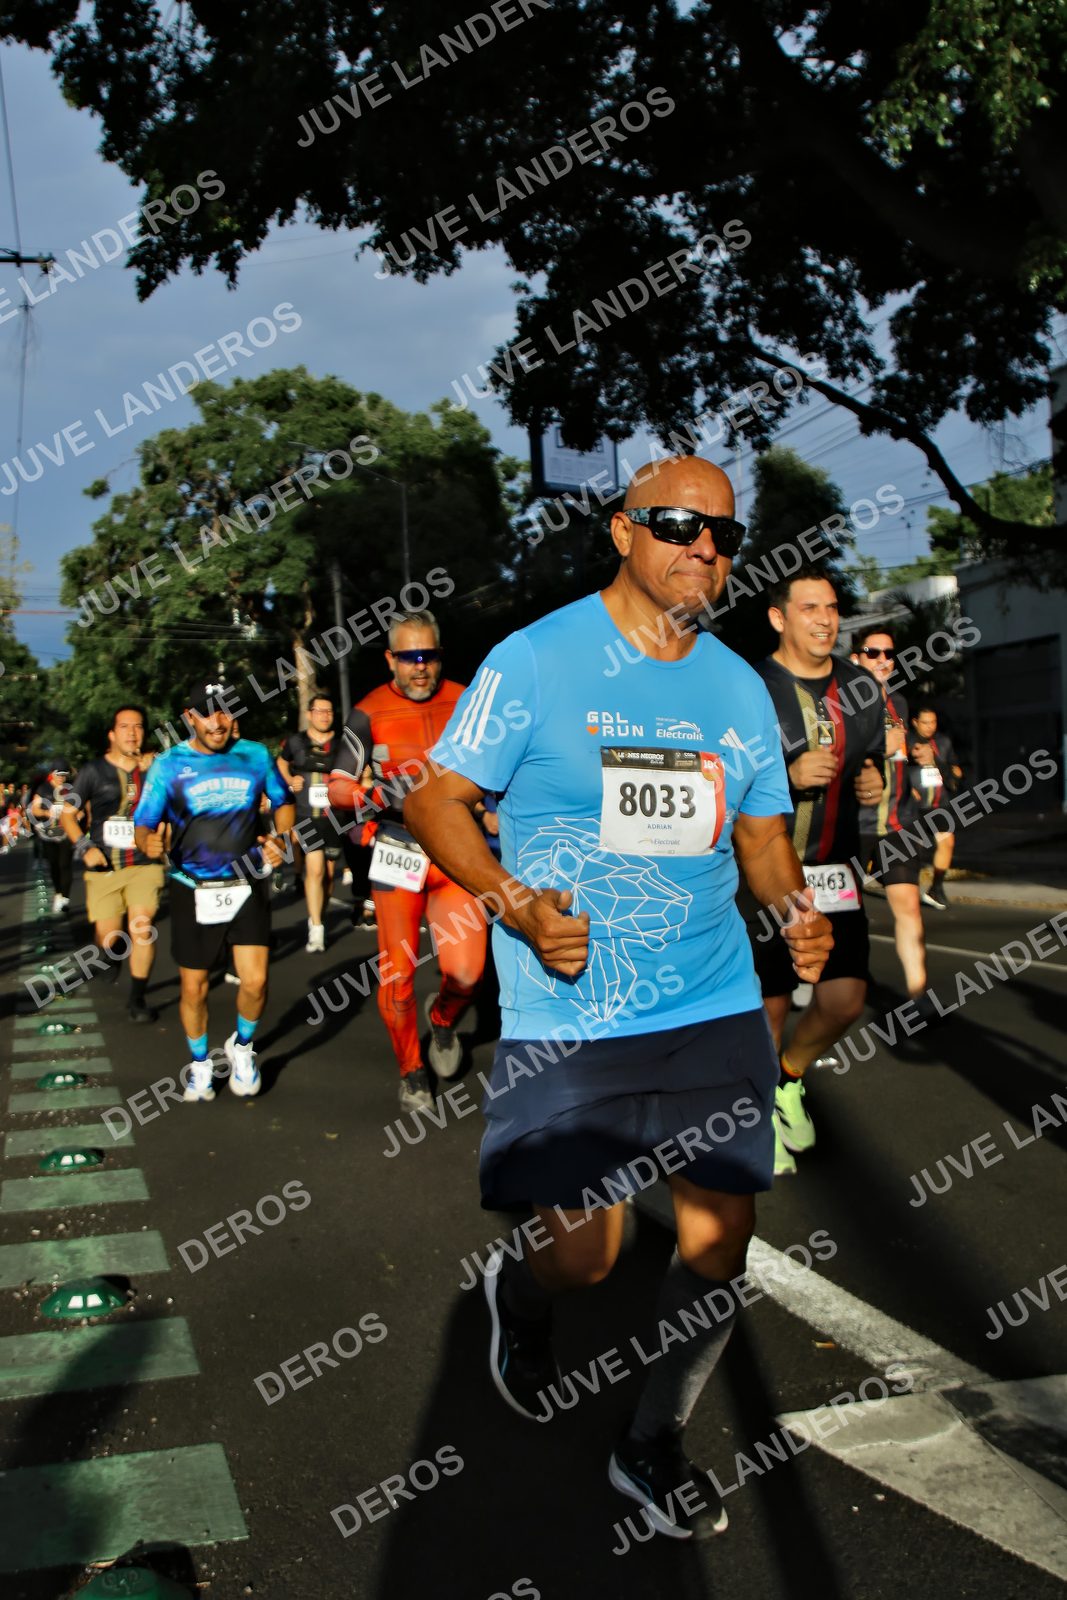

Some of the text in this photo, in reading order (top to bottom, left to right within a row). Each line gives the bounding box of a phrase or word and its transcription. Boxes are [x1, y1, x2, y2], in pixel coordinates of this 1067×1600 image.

[587, 711, 628, 723] GDL
[602, 725, 644, 737] RUN
[656, 728, 704, 741] Electrolit
[619, 781, 697, 819] 8033
[377, 849, 421, 873] 10409
[806, 872, 846, 891] 8463
[215, 893, 233, 908] 56
